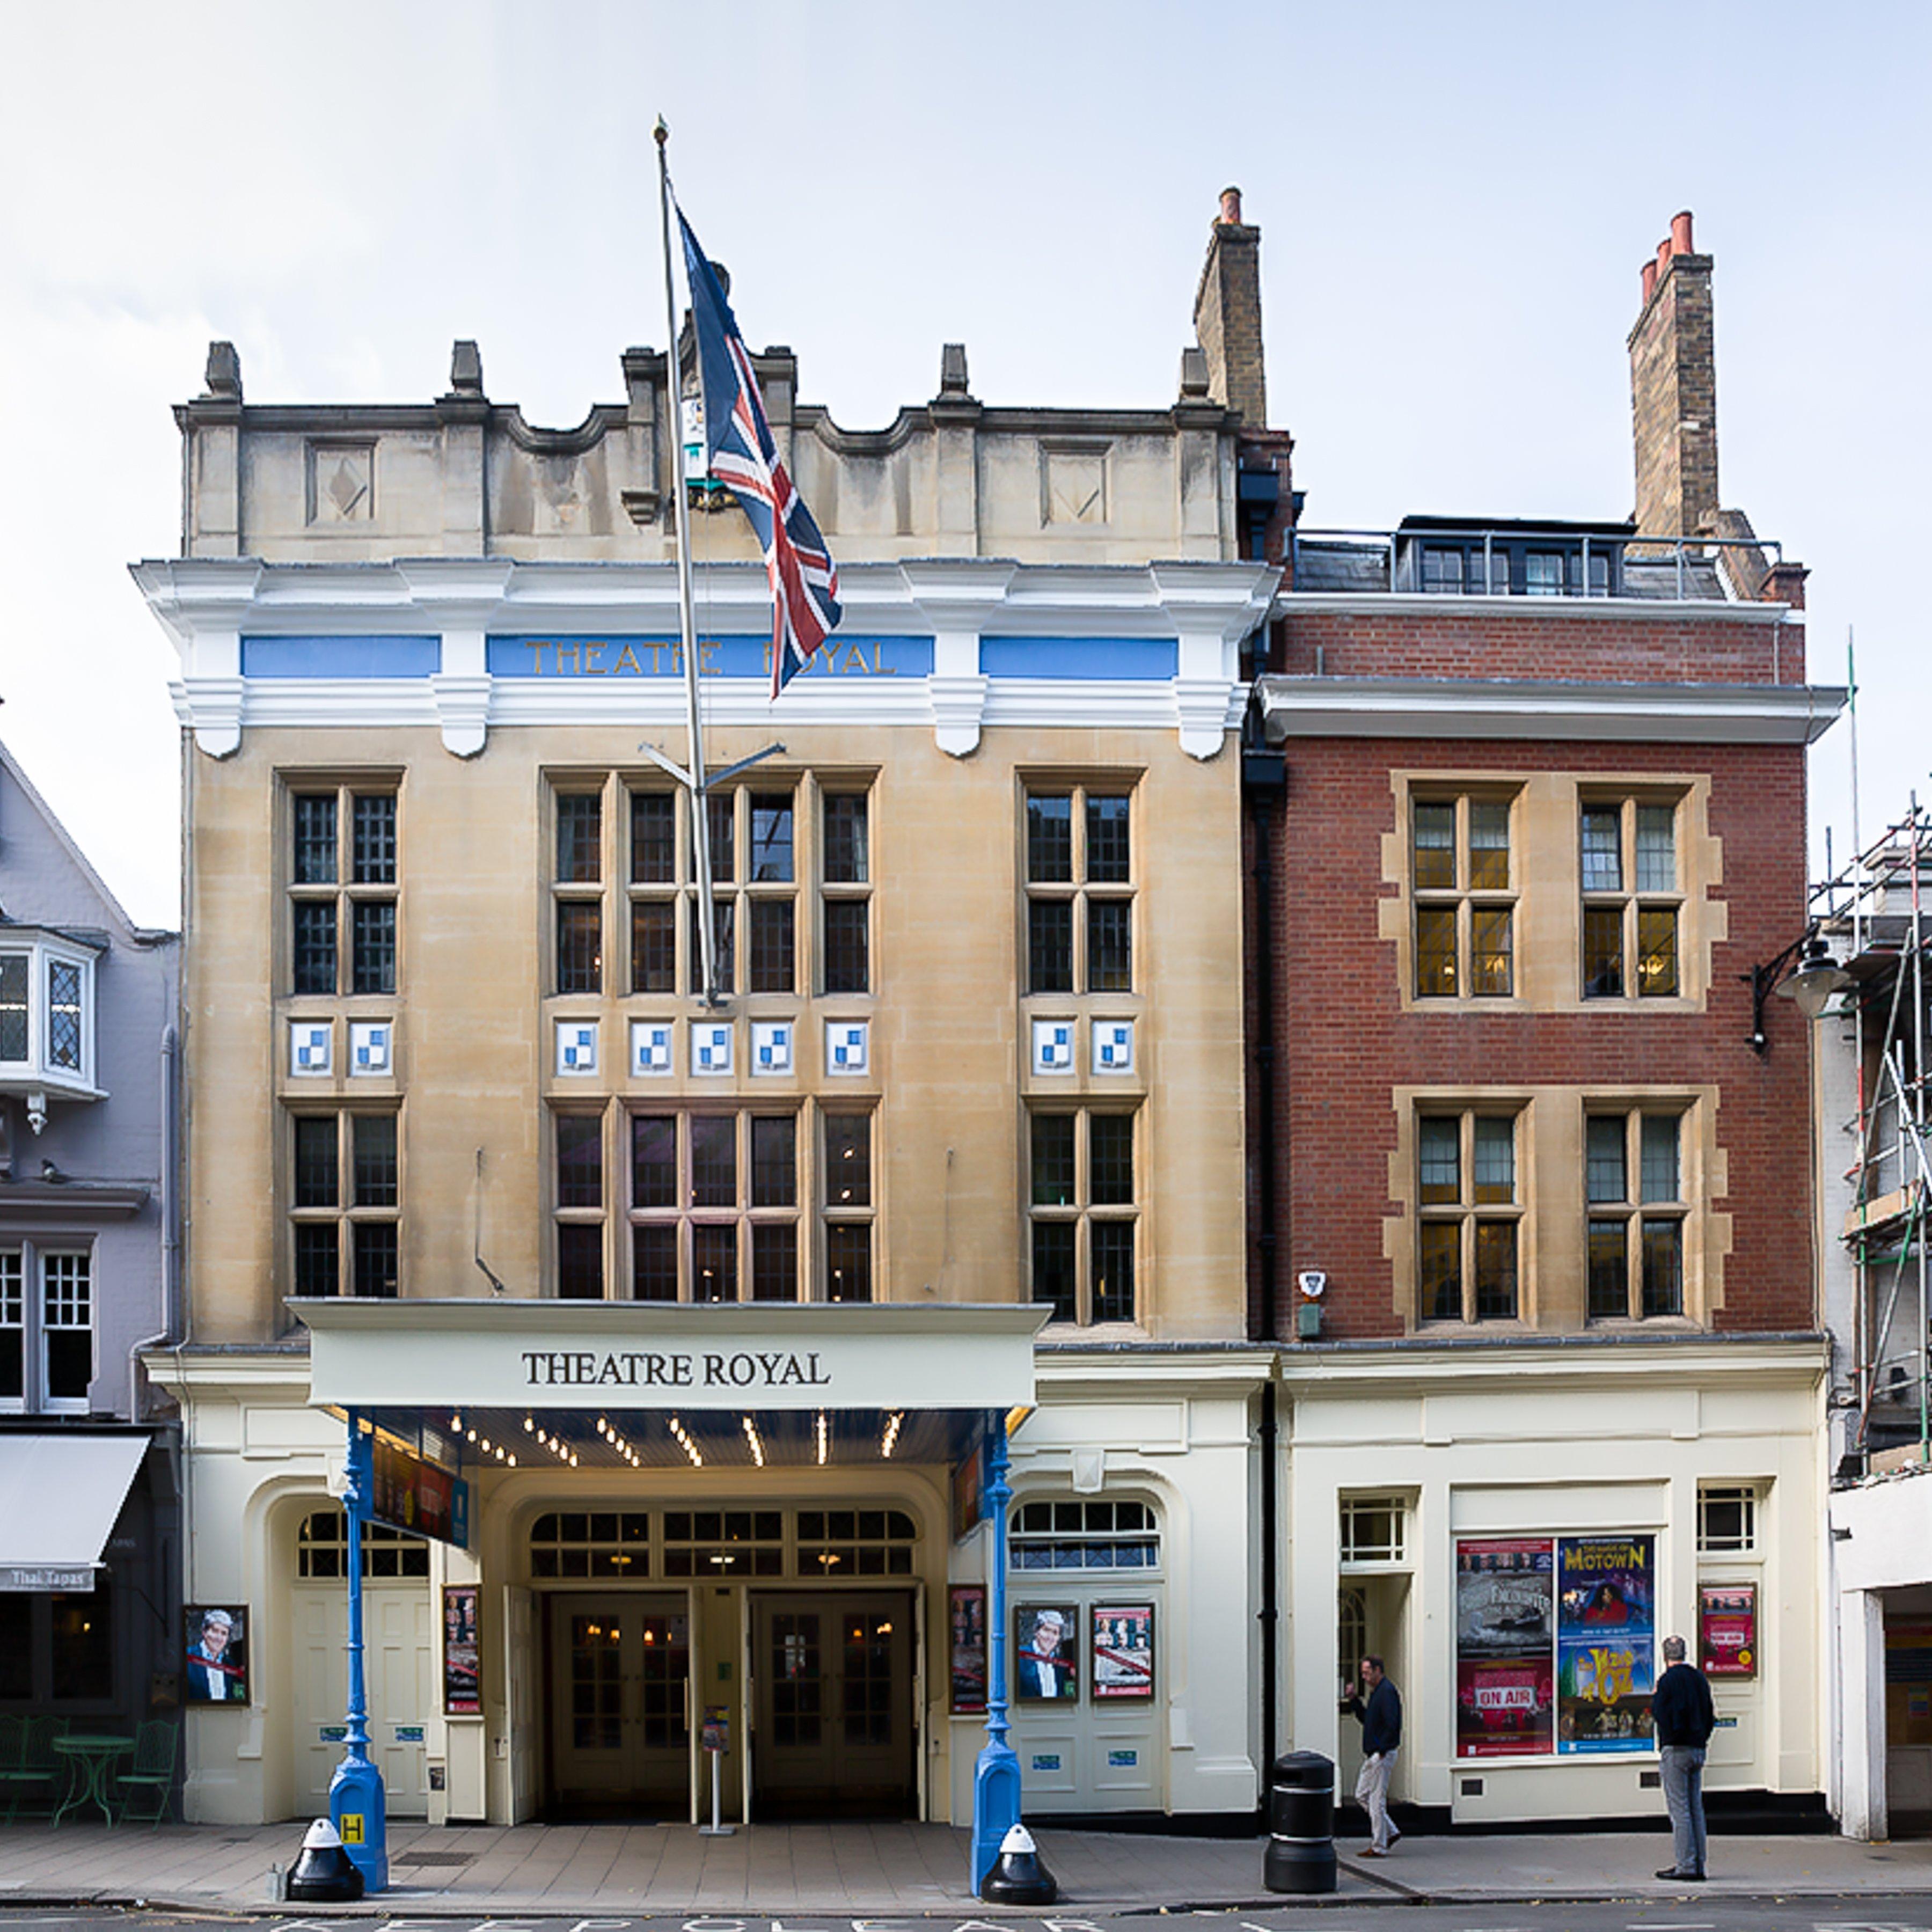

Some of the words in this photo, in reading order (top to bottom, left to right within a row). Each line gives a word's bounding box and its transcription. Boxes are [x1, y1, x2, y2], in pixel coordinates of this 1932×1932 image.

[522, 1352, 693, 1385] THEATRE
[702, 1352, 831, 1385] ROYAL
[1564, 1545, 1646, 1571] MOTOWN
[1480, 1691, 1502, 1706] ON
[1504, 1690, 1531, 1704] AIR
[343, 1816, 361, 1841] H
